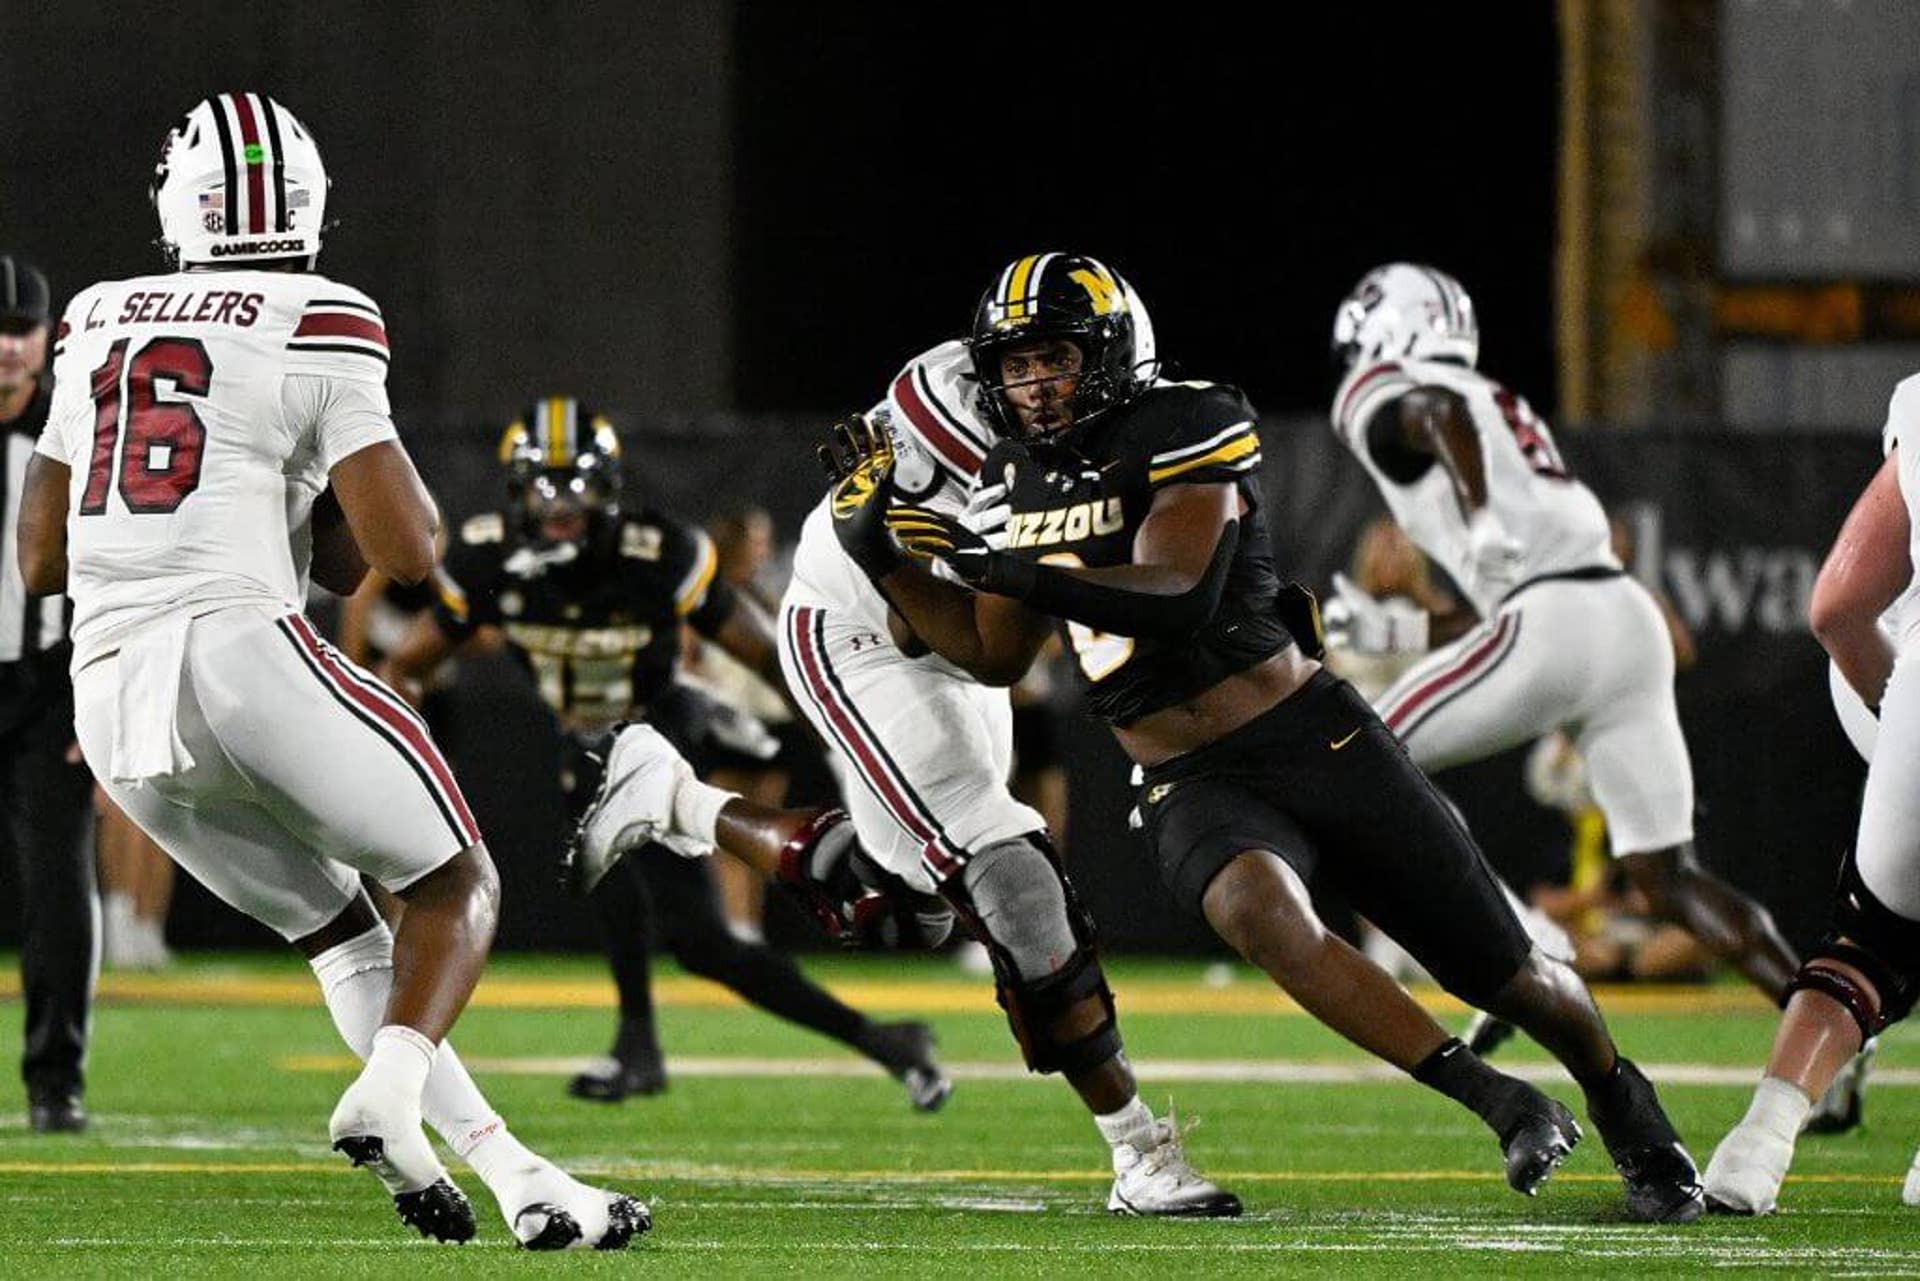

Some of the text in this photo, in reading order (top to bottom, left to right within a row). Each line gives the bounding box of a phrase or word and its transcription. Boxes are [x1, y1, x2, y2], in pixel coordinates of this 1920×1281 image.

[210, 239, 305, 257] GAMECOCKS
[84, 290, 265, 332] L. SELLERS
[79, 336, 214, 516] 16
